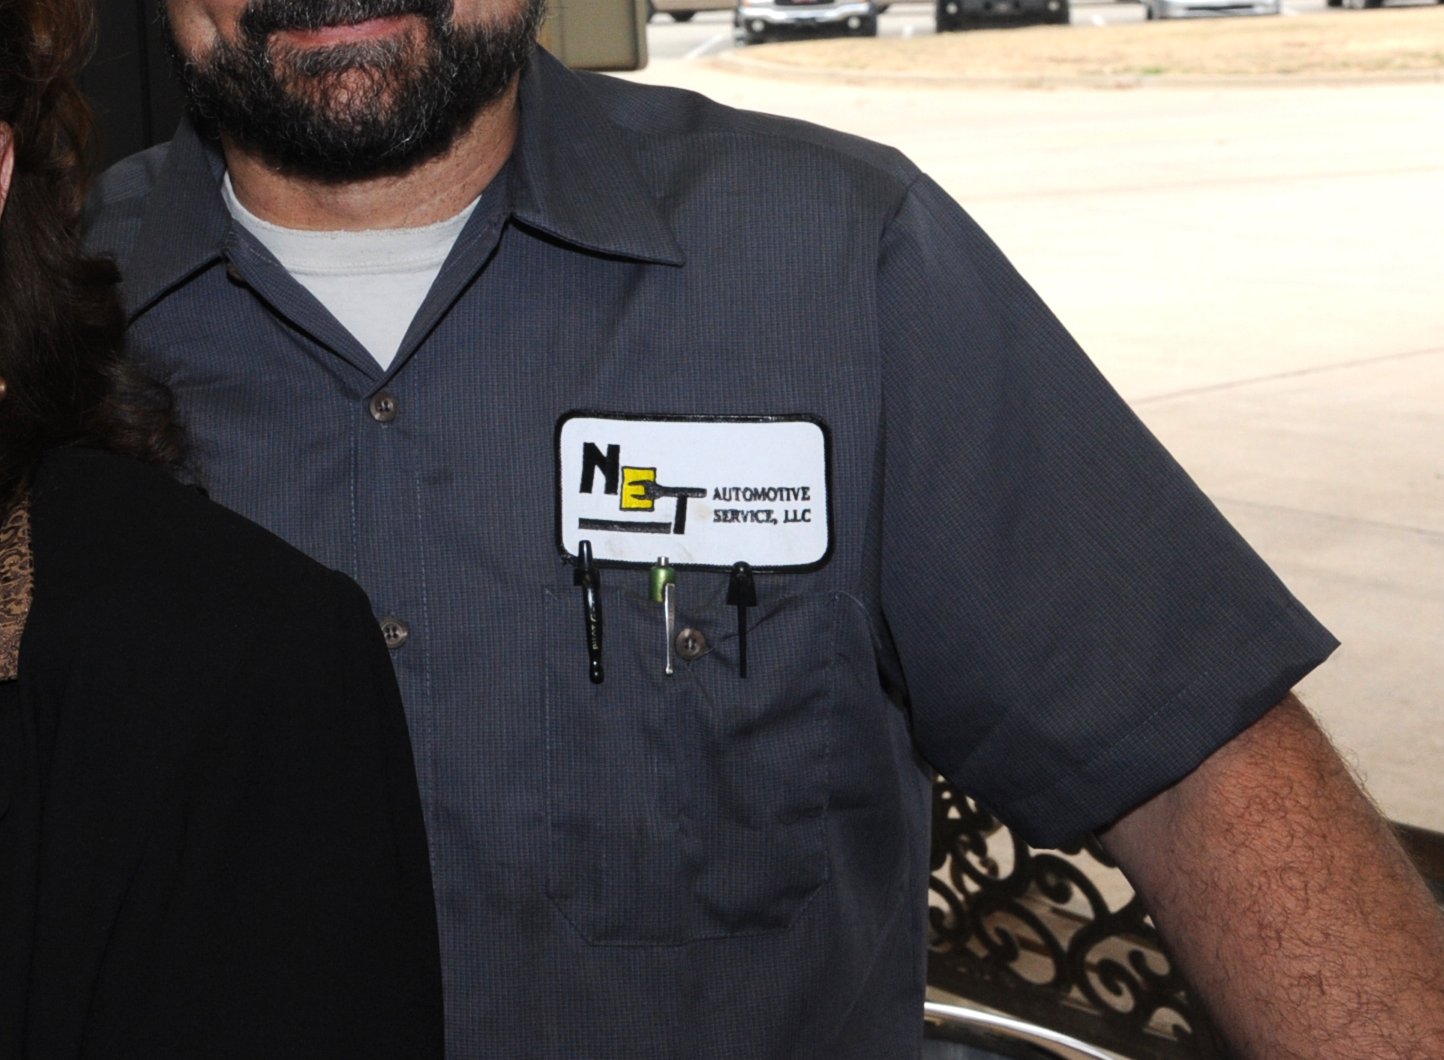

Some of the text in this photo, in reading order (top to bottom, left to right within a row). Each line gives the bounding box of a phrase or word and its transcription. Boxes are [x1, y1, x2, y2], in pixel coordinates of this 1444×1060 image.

[713, 487, 811, 502] AUTOMOTIVE
[713, 509, 811, 525] SERVICE, LLC
